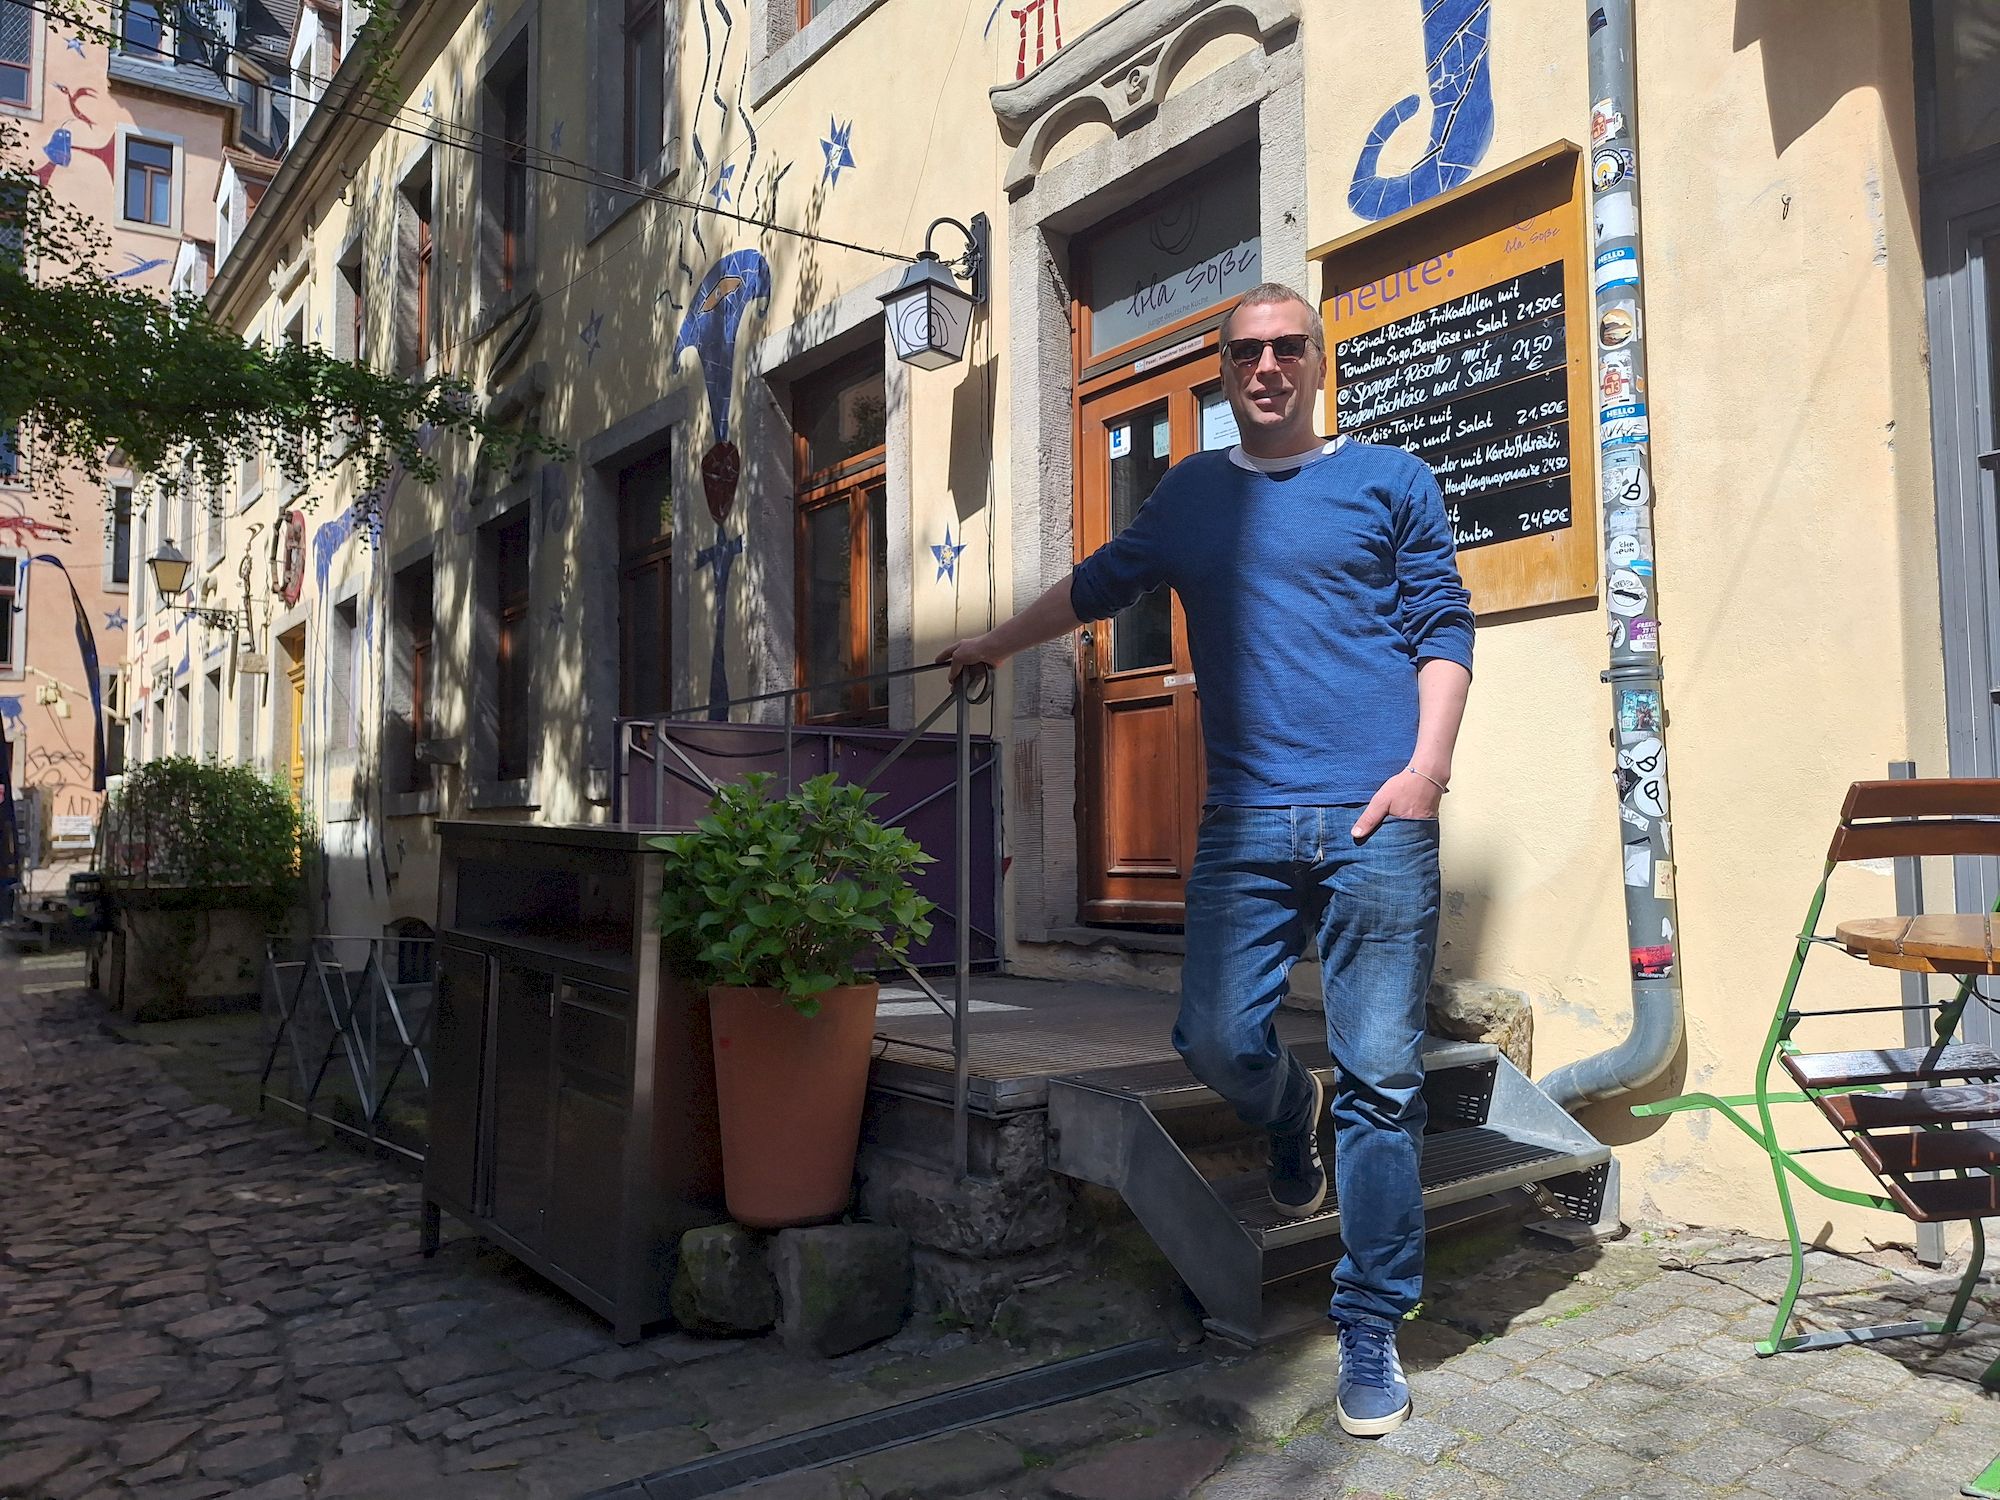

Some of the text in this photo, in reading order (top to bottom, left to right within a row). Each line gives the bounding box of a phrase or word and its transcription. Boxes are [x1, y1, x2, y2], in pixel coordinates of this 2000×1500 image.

[1185, 249, 1256, 295] Soße
[1597, 249, 1626, 265] HELLO
[1334, 251, 1455, 322] heute:
[1498, 279, 1520, 303] mit
[1476, 309, 1508, 336] Salat
[1517, 293, 1562, 320] 21,50€
[1338, 354, 1503, 428] Ziegenfrischkäse und Salat
[1351, 354, 1451, 409] Spargel-Risotto
[1461, 340, 1492, 365] mit
[1423, 425, 1451, 448] und
[1455, 411, 1494, 437] Salat
[1517, 400, 1567, 425] 21,50€
[1430, 405, 1452, 426] mit
[1606, 406, 1635, 419] HELLO
[1460, 447, 1483, 469] mit
